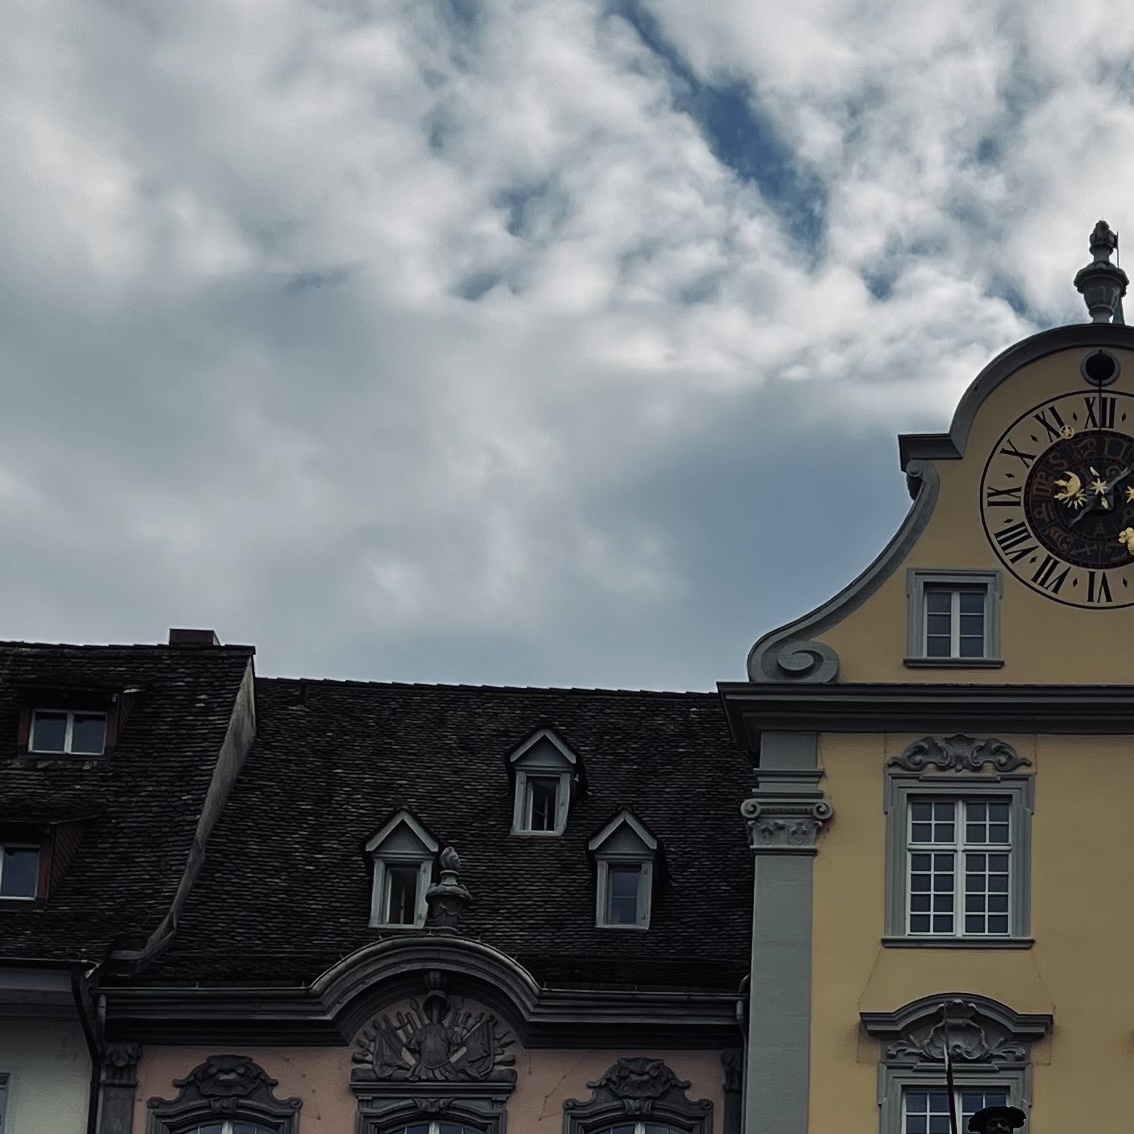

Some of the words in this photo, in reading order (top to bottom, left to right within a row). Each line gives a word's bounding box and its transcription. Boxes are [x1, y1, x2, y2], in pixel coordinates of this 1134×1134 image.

[1033, 406, 1066, 443] XI
[1084, 397, 1117, 429] XII
[999, 440, 1037, 469] X
[987, 486, 1022, 507] IX
[994, 521, 1039, 564] VIII
[1031, 554, 1071, 594] VII
[1087, 571, 1113, 602] VI
